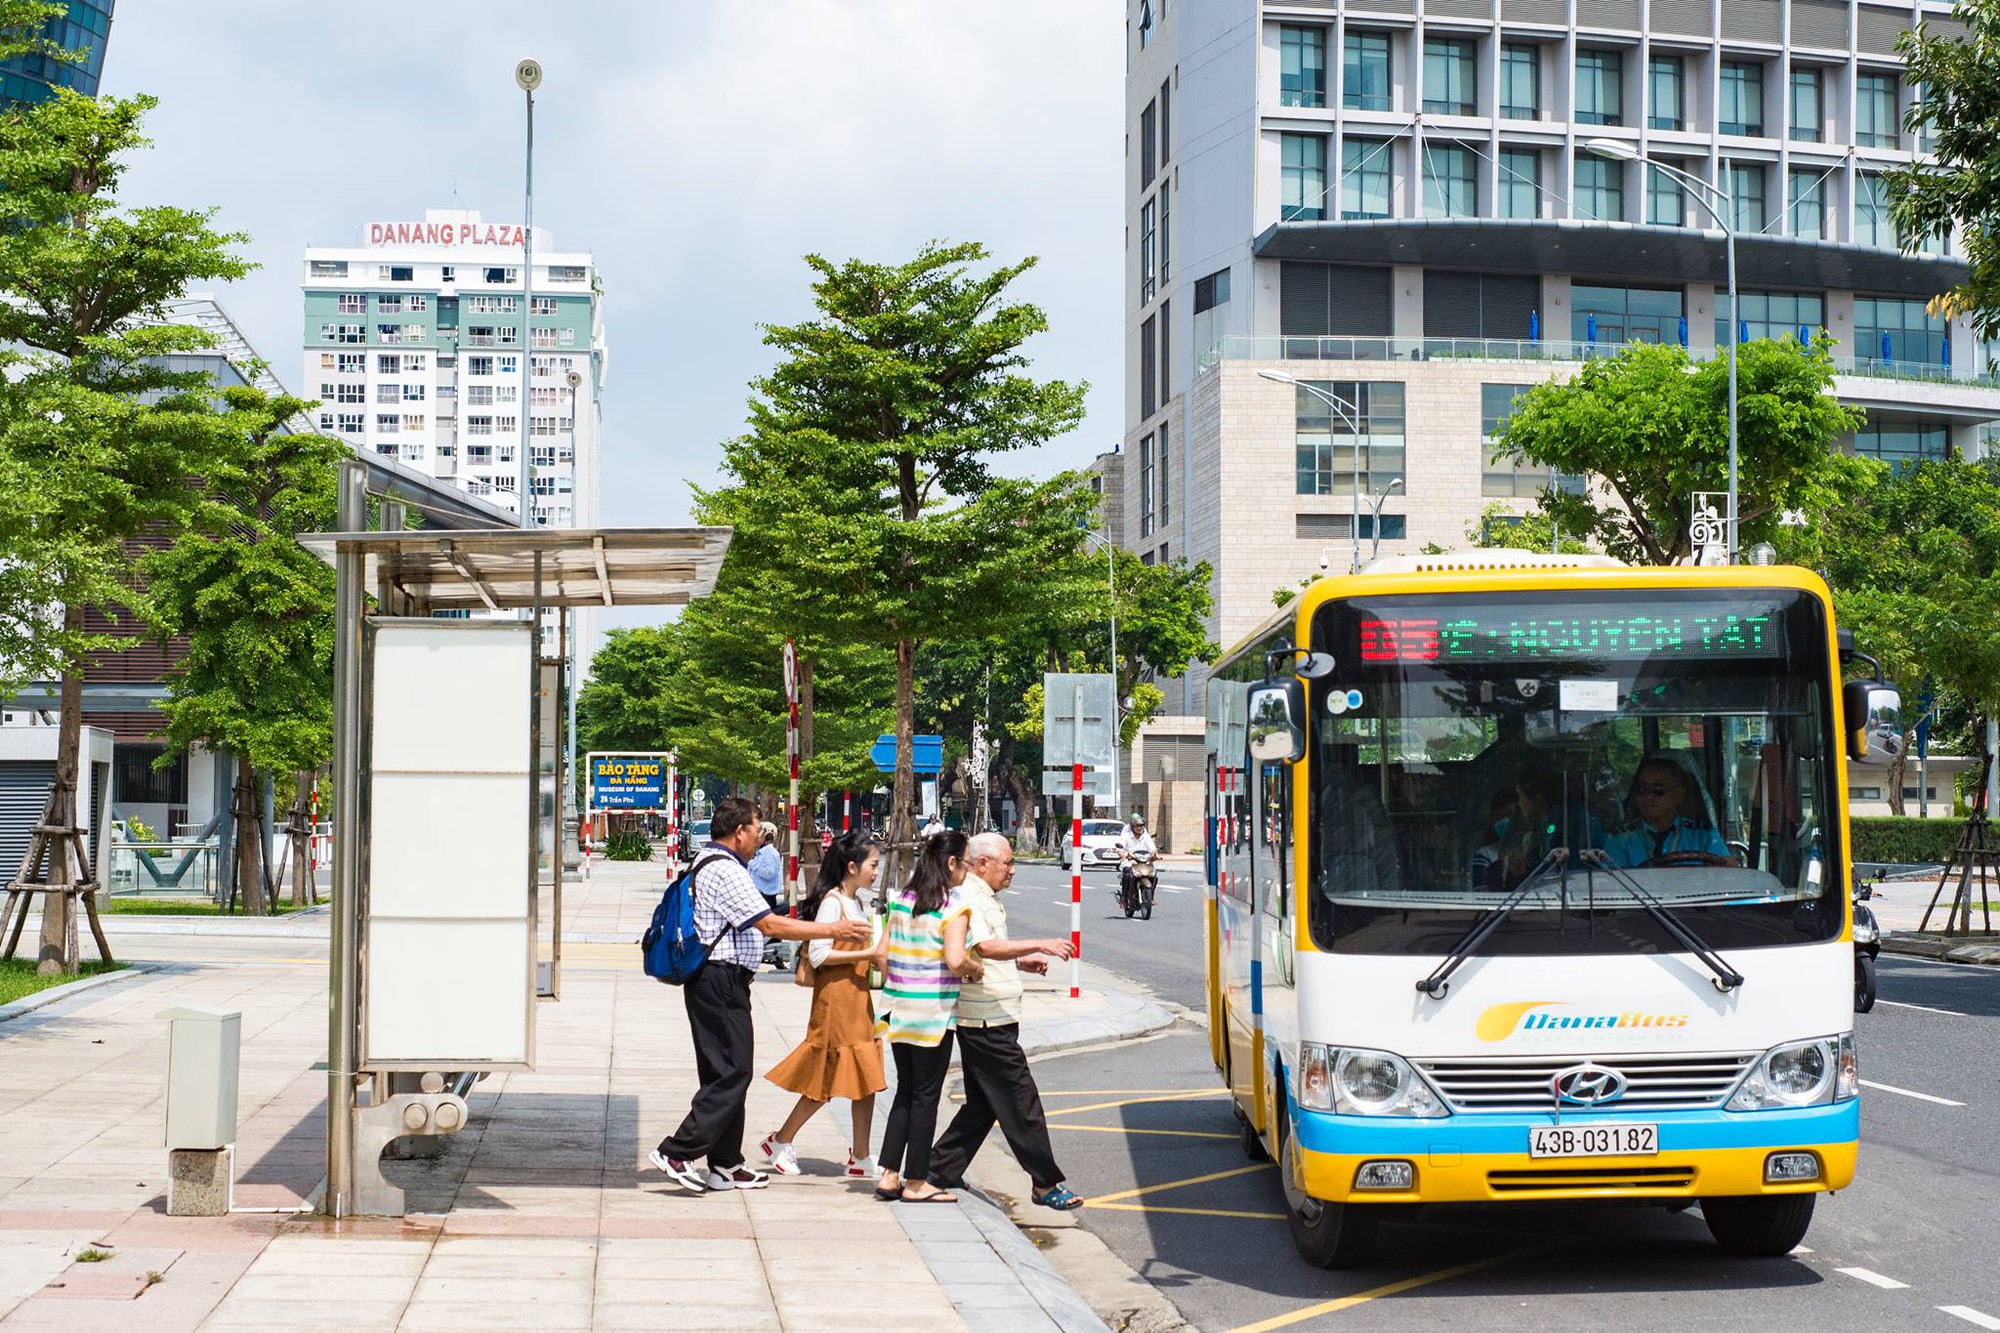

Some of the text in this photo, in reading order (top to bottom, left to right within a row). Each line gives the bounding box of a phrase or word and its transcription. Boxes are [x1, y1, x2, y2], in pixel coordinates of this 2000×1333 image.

[371, 223, 525, 247] DANANG PLAZA
[598, 761, 659, 776] BẢO TÀNG
[1535, 1128, 1654, 1154] 43B-031.82
